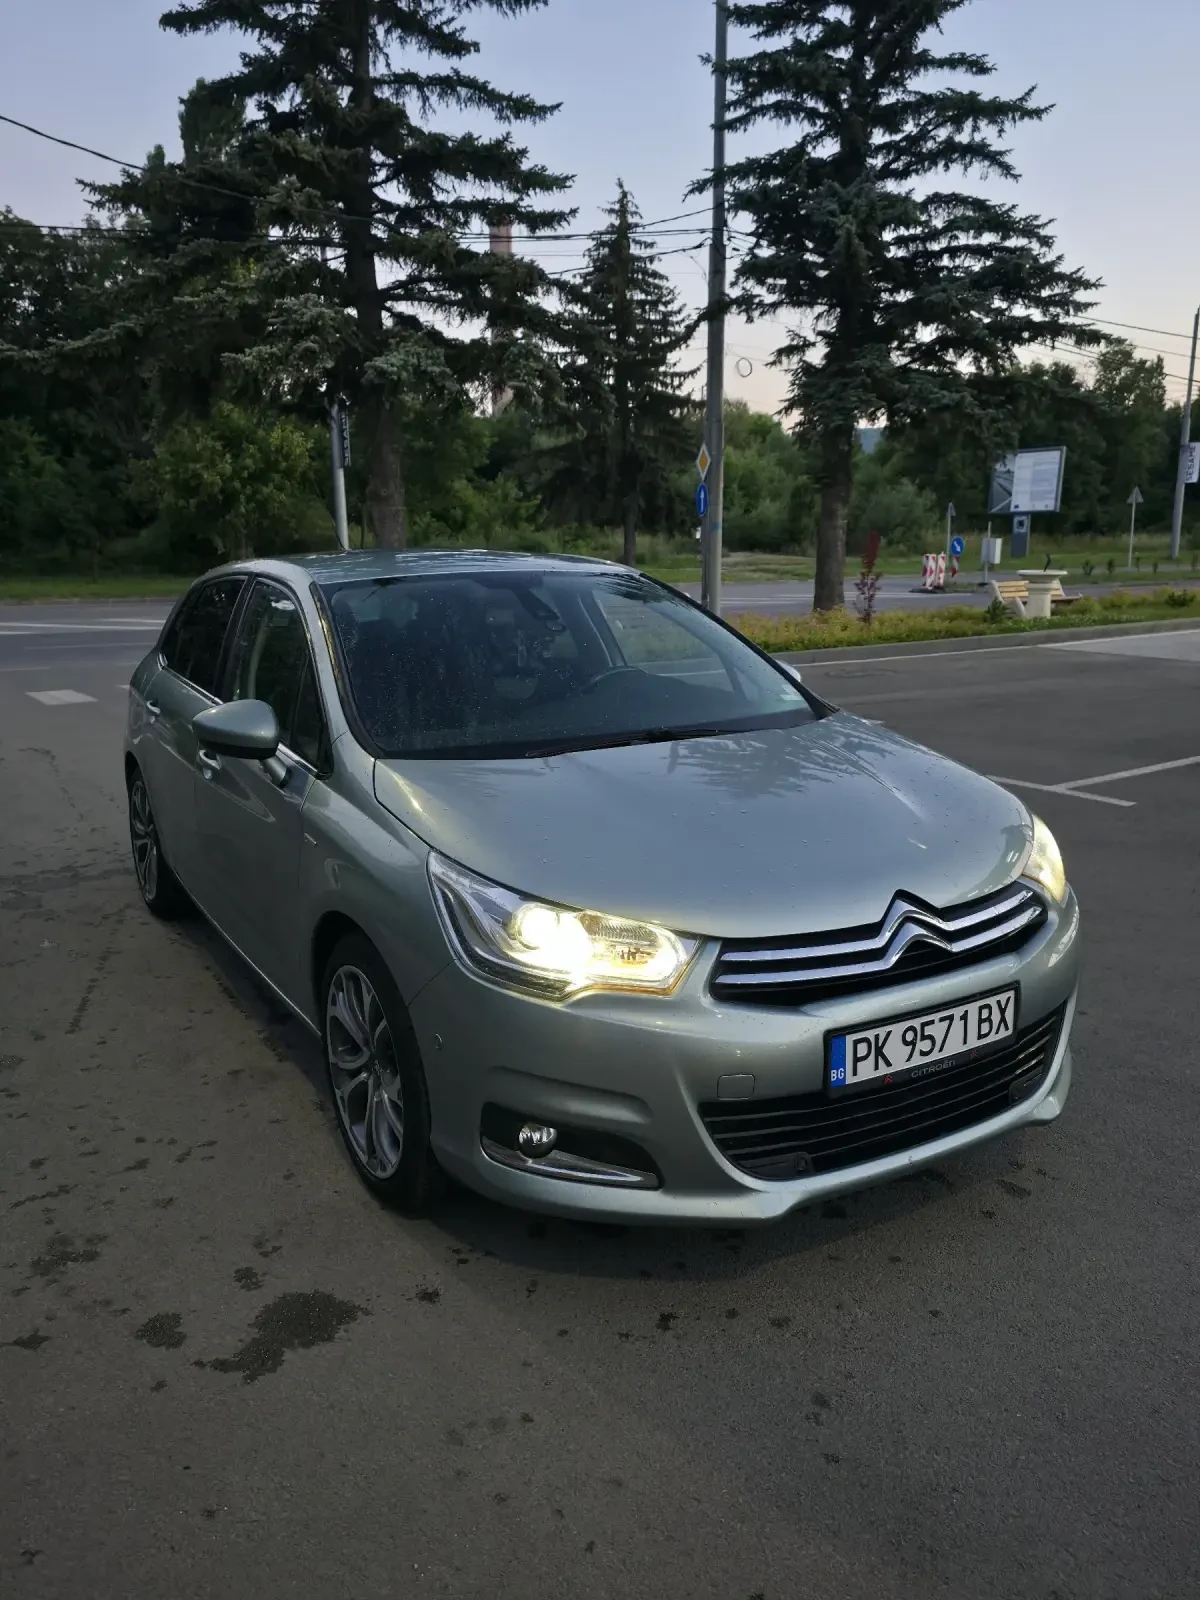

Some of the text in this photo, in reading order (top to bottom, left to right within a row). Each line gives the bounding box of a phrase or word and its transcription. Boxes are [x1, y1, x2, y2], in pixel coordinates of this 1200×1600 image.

[1185, 444, 1196, 481] SESAME
[852, 995, 1012, 1077] PK 9571 BX
[830, 1068, 845, 1082] BG
